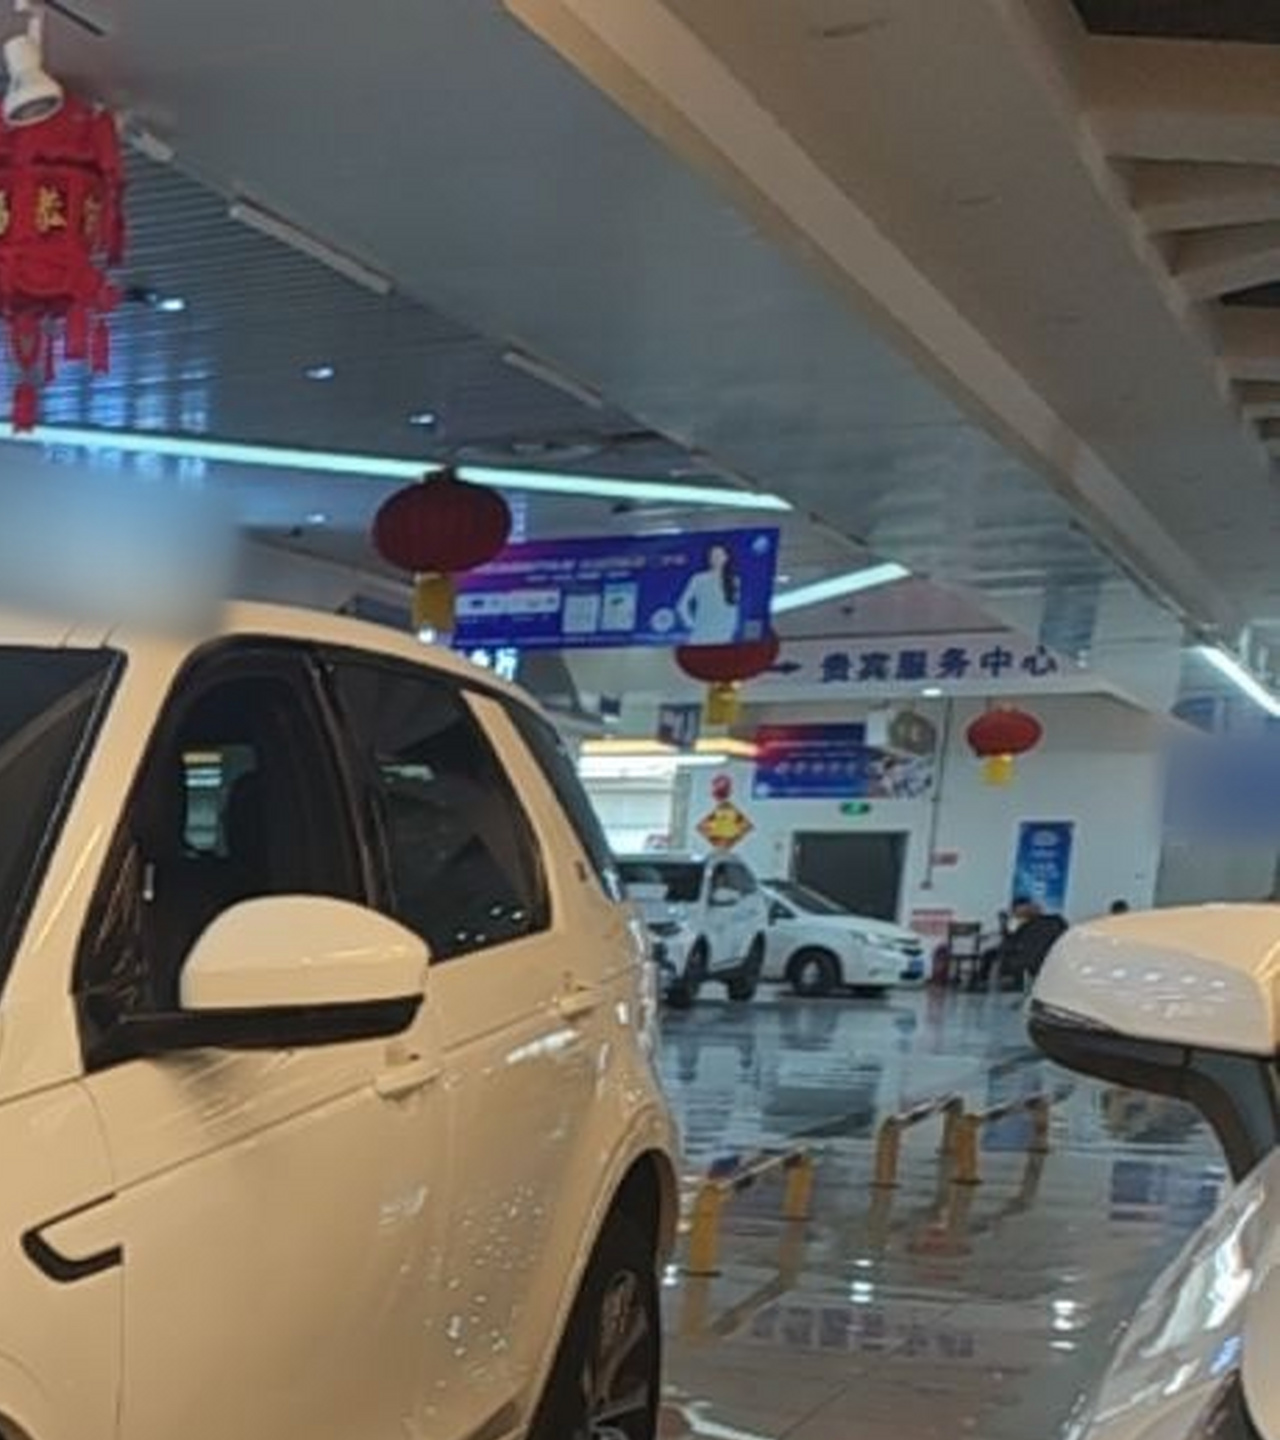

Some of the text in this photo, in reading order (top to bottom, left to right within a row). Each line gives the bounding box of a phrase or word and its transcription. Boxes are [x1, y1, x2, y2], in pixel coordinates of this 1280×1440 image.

[820, 645, 1058, 684] 贵宾服务中心
